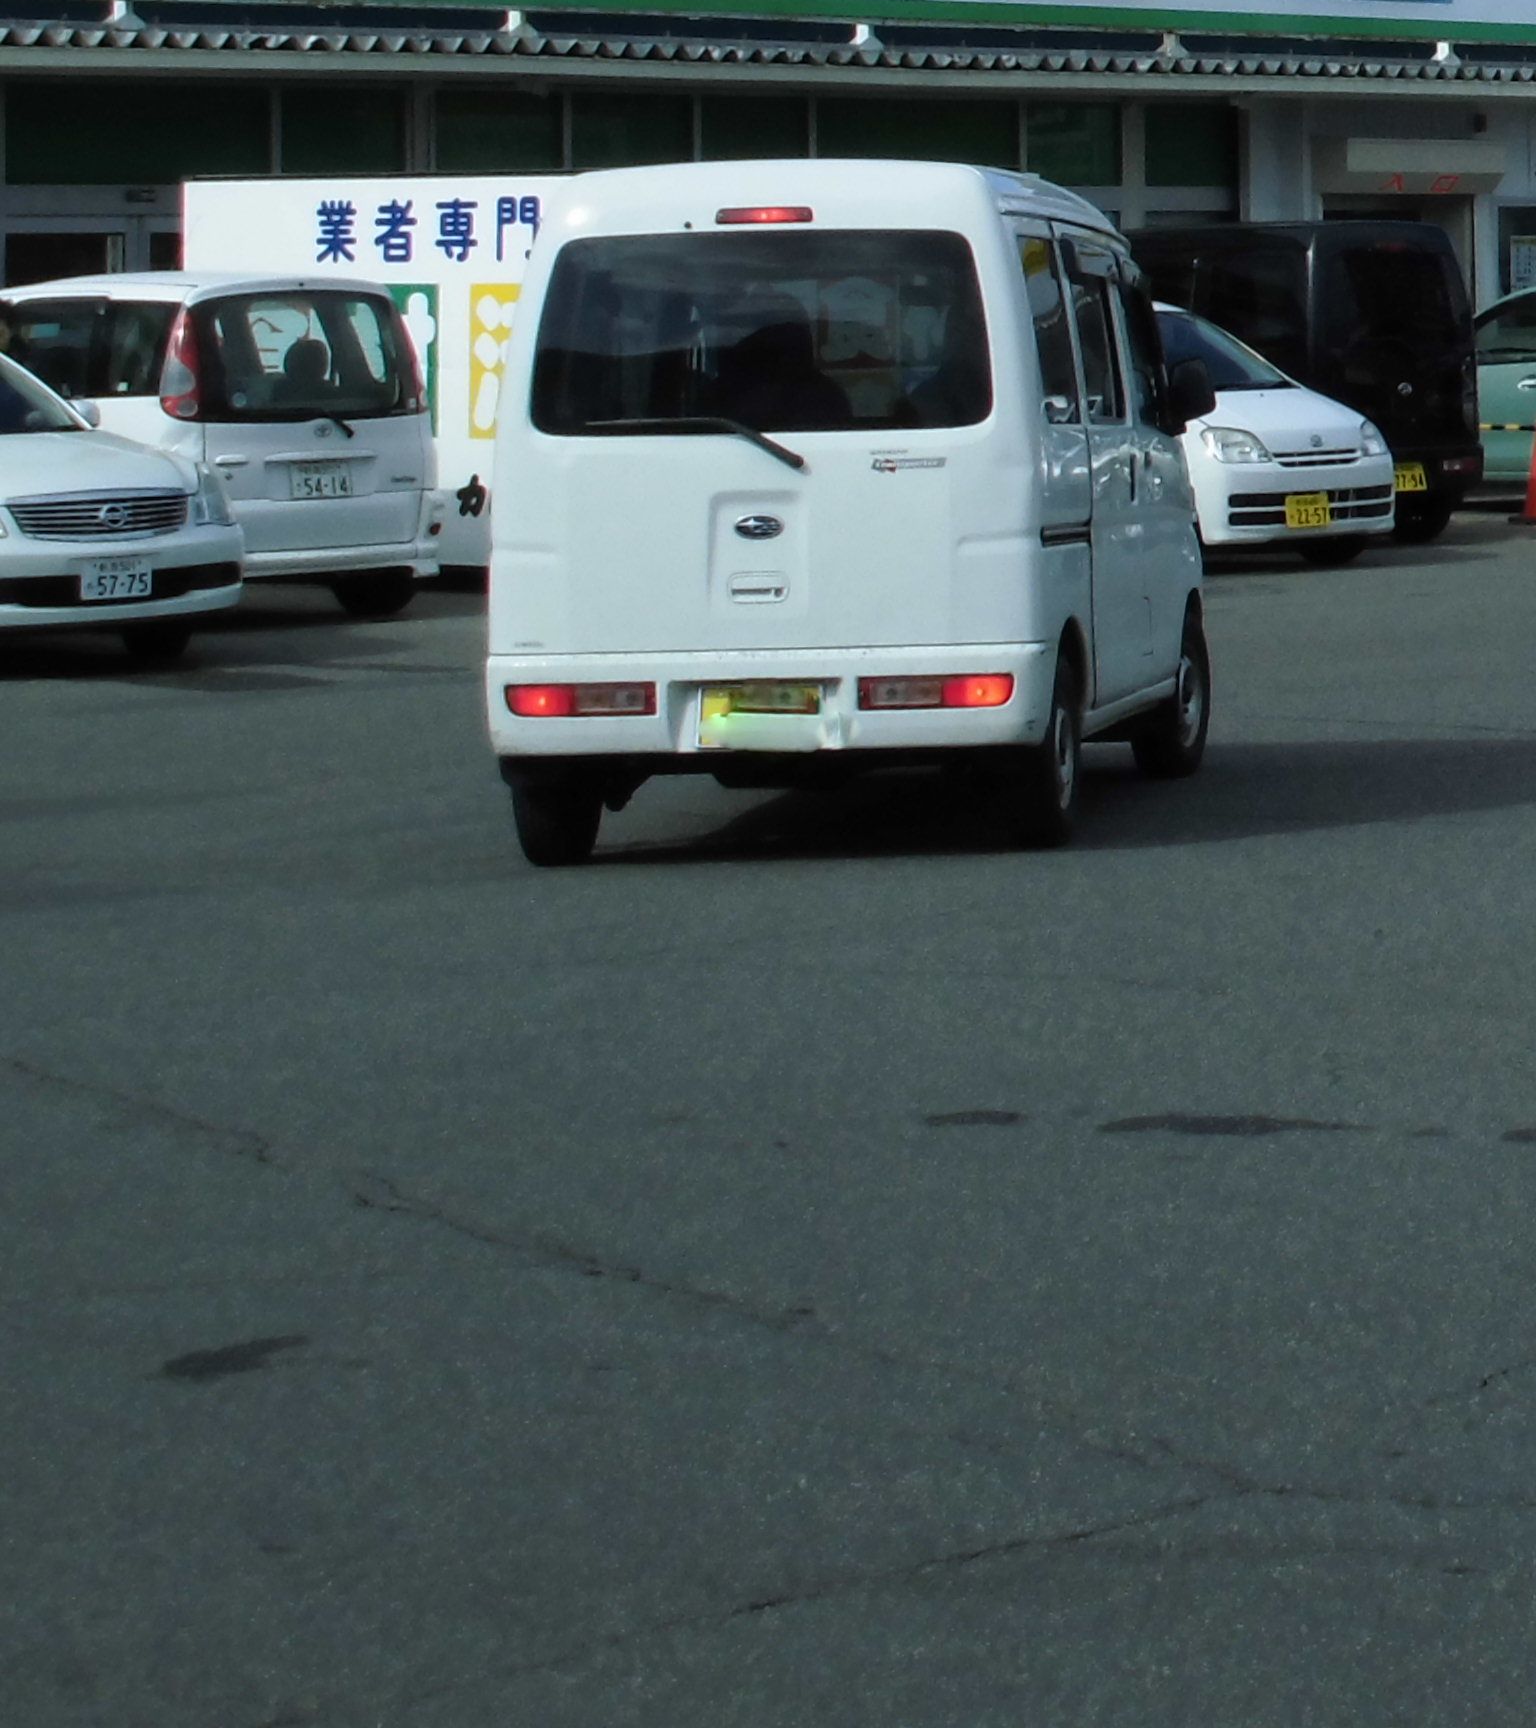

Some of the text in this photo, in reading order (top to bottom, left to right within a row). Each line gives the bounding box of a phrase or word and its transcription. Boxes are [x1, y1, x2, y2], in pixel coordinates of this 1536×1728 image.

[1380, 171, 1460, 193] 入口
[315, 195, 542, 264] 業者専門
[97, 572, 149, 596] 57-75
